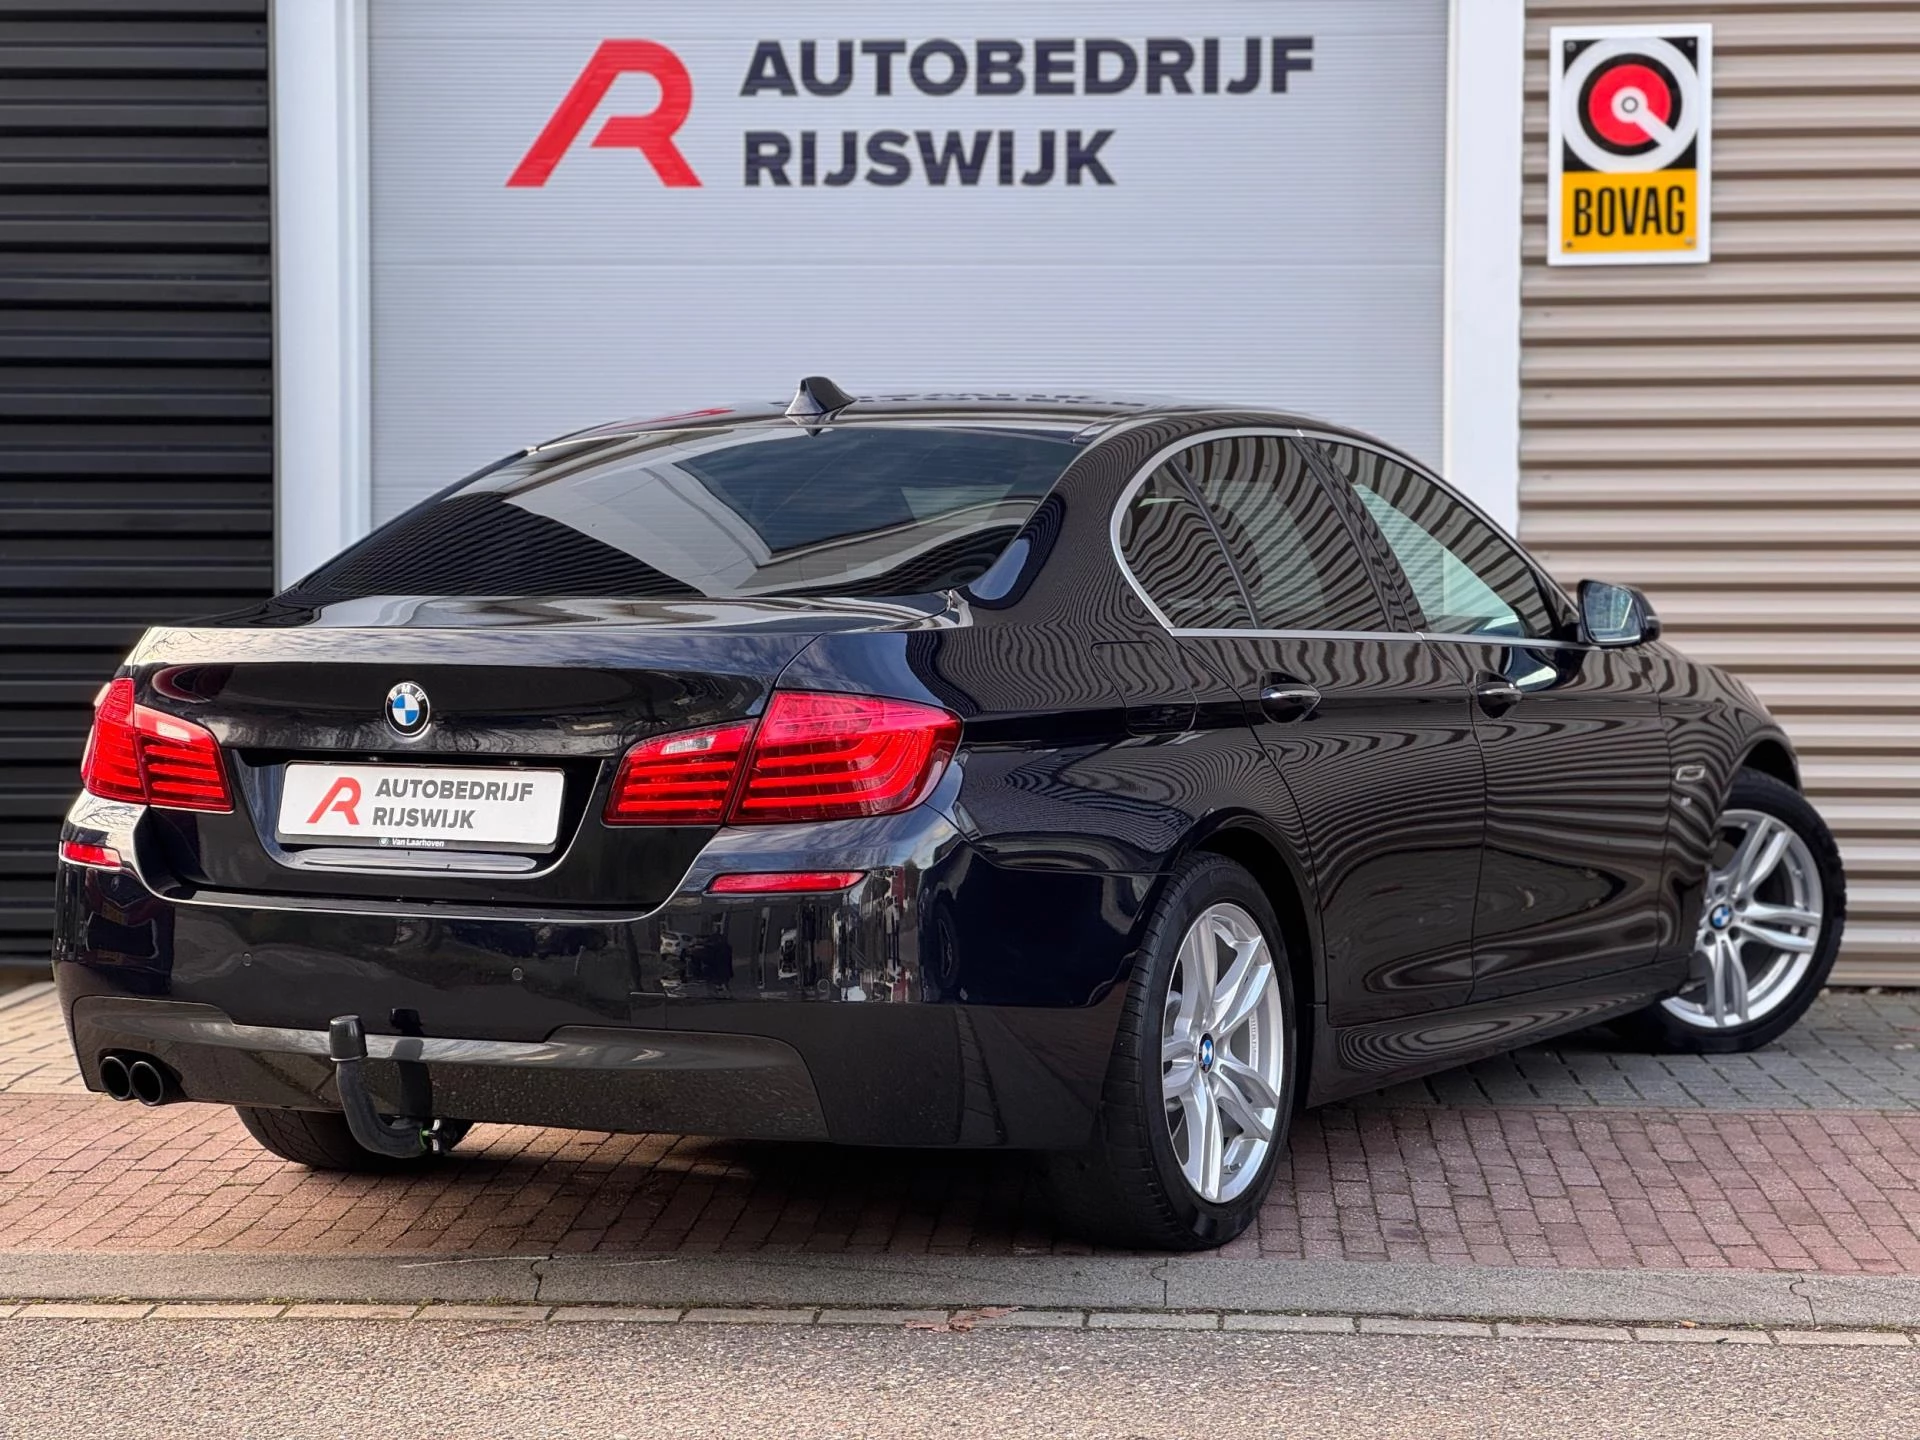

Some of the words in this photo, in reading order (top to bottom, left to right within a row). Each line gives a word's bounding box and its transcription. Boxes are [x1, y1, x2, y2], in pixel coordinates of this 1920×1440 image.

[740, 36, 1315, 97] AUTOBEDRIJF
[744, 129, 1116, 188] RIJSWIJK
[1573, 185, 1686, 238] BOVAG
[375, 778, 534, 802] AUTOBEDRIJF
[372, 806, 476, 829] RIJSWIJK
[392, 838, 406, 846] Van
[406, 838, 445, 847] Laarhoven
